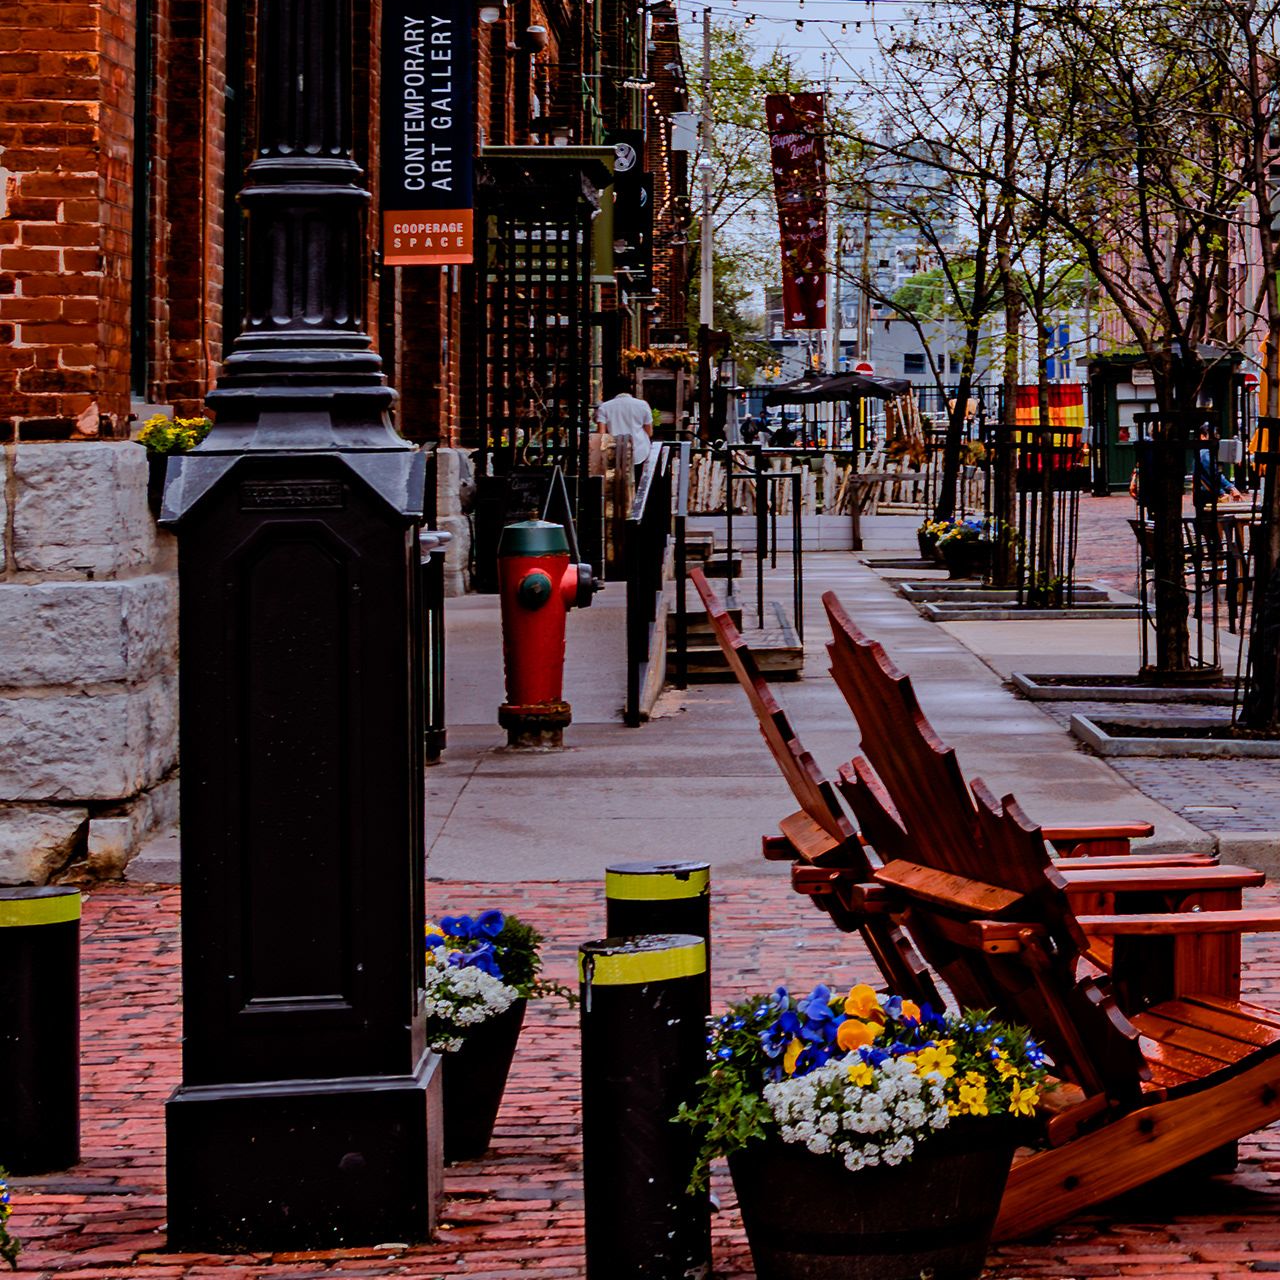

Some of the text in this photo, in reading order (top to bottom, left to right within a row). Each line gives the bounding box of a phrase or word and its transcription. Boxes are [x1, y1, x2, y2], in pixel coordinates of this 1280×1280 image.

[404, 15, 425, 191] CONTEMPORARY
[432, 15, 452, 191] ART GALLERY
[393, 222, 464, 234] COOPERAGE
[393, 236, 464, 248] SPACE
